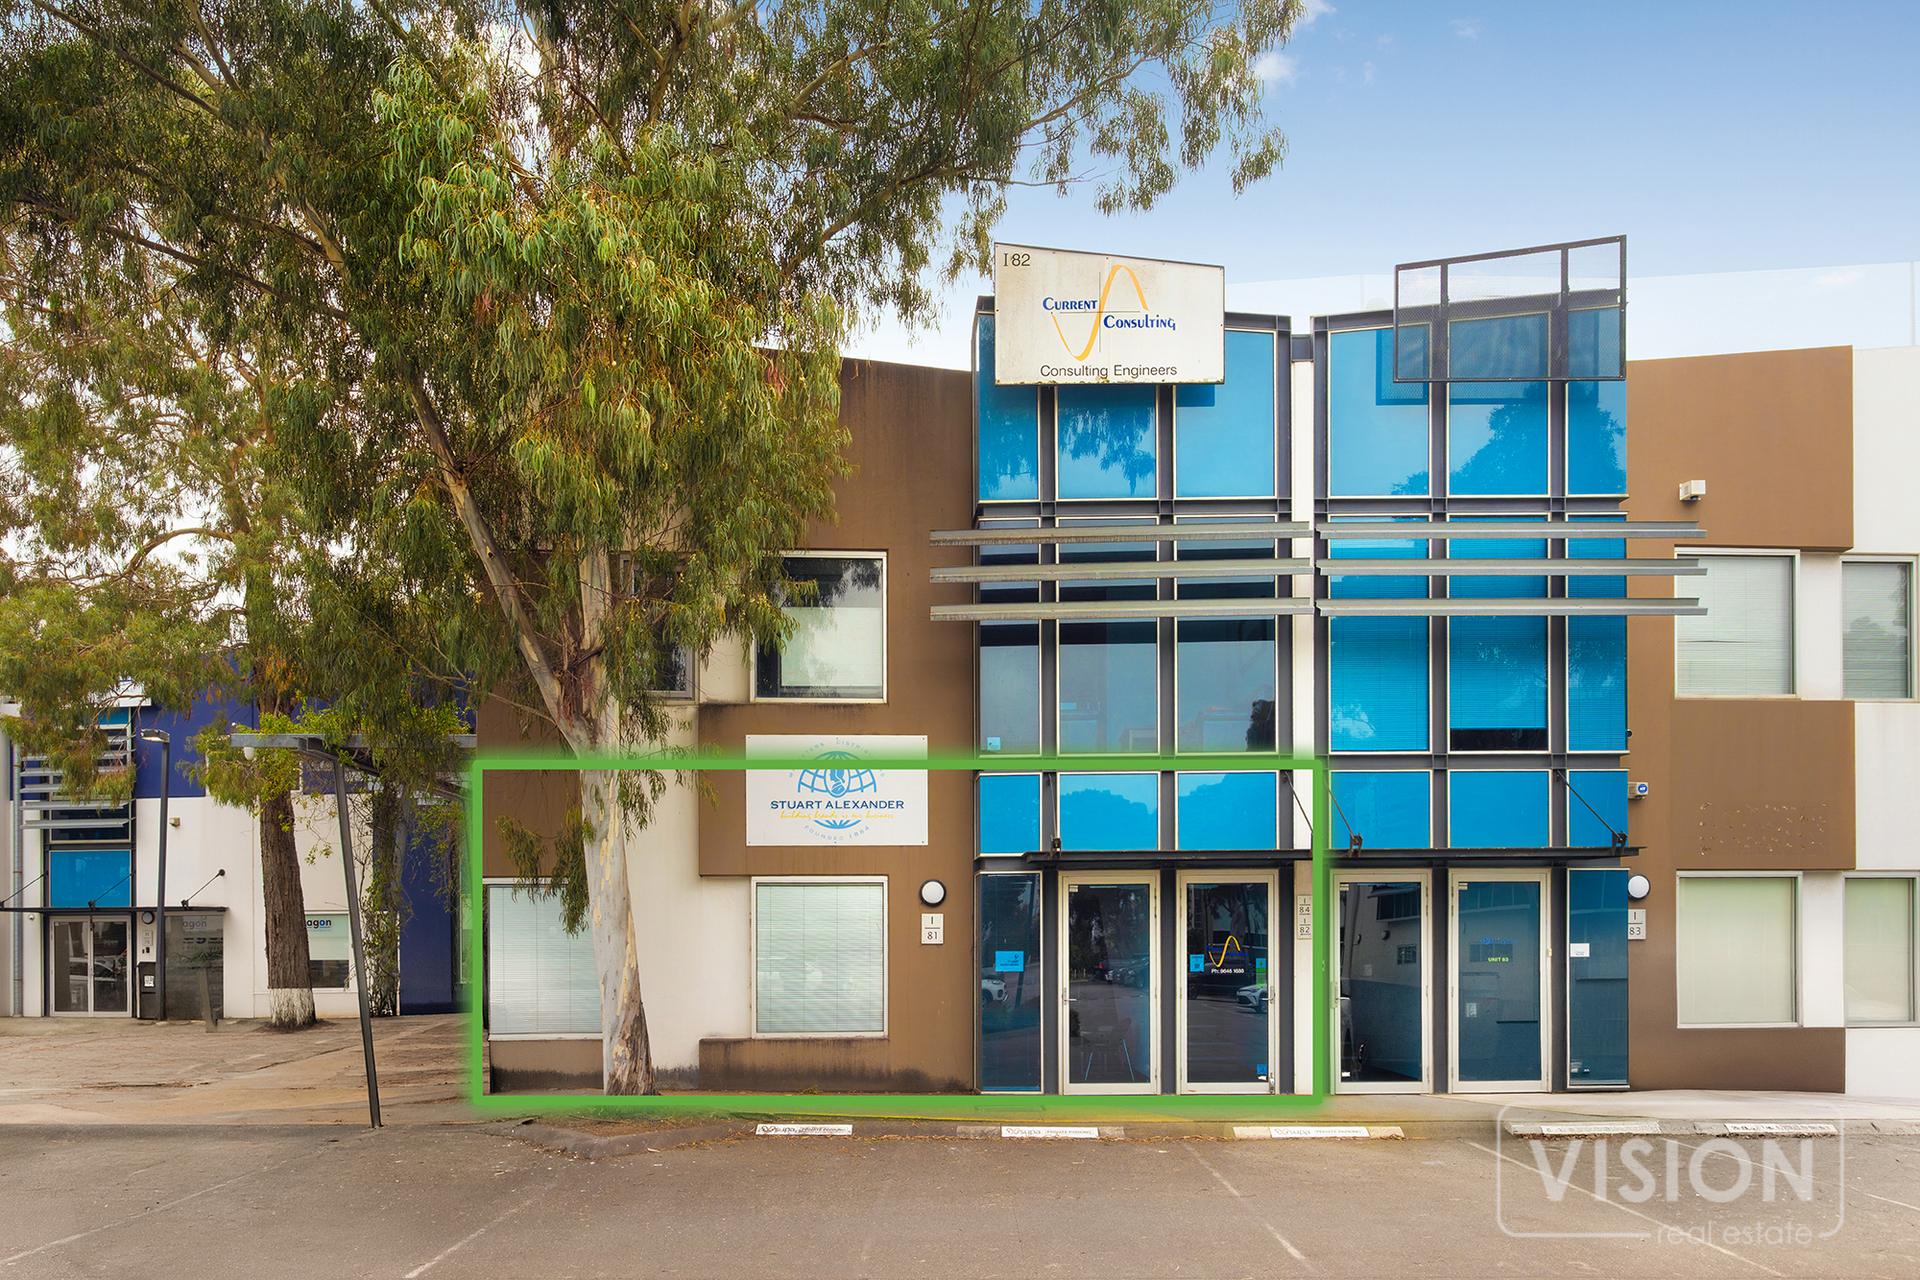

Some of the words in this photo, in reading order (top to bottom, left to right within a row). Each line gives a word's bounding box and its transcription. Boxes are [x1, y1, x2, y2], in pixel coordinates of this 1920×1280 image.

[1042, 296, 1098, 311] CURRENT
[1103, 314, 1176, 331] Consulting
[1040, 364, 1109, 379] Consulting
[1113, 364, 1178, 379] Engineers
[770, 800, 823, 810] STUART
[825, 800, 905, 810] ALEXANDER
[780, 810, 812, 822] building
[866, 810, 894, 820] business
[804, 825, 844, 841] FOUNDED
[182, 920, 207, 930] agon
[307, 919, 332, 929] agon
[1300, 926, 1310, 934] 82
[1629, 926, 1642, 936] 83
[927, 931, 938, 940] 81
